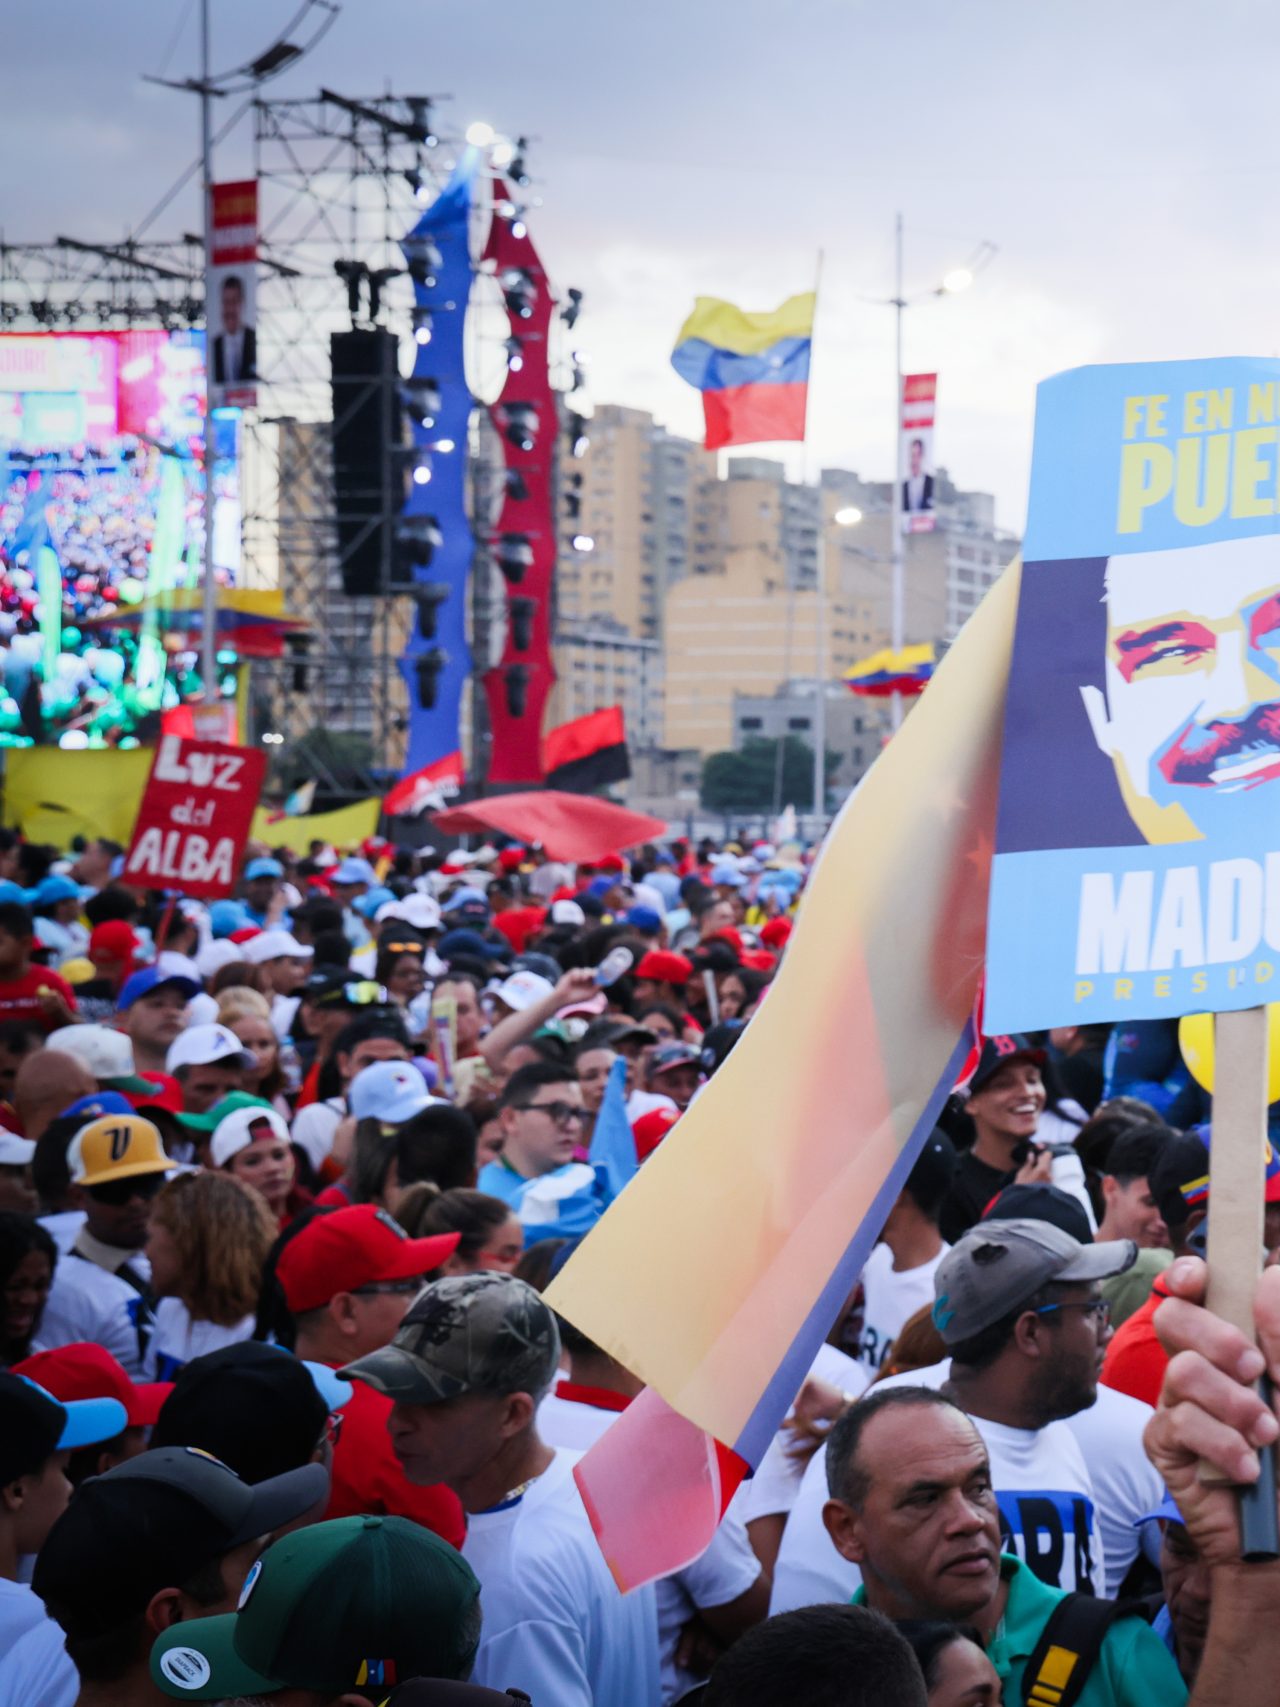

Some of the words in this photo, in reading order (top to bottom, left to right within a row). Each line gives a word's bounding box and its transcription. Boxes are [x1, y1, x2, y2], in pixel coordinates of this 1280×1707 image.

[1121, 394, 1170, 440] FE
[1183, 387, 1235, 434] EN
[126, 826, 236, 885] ALBA
